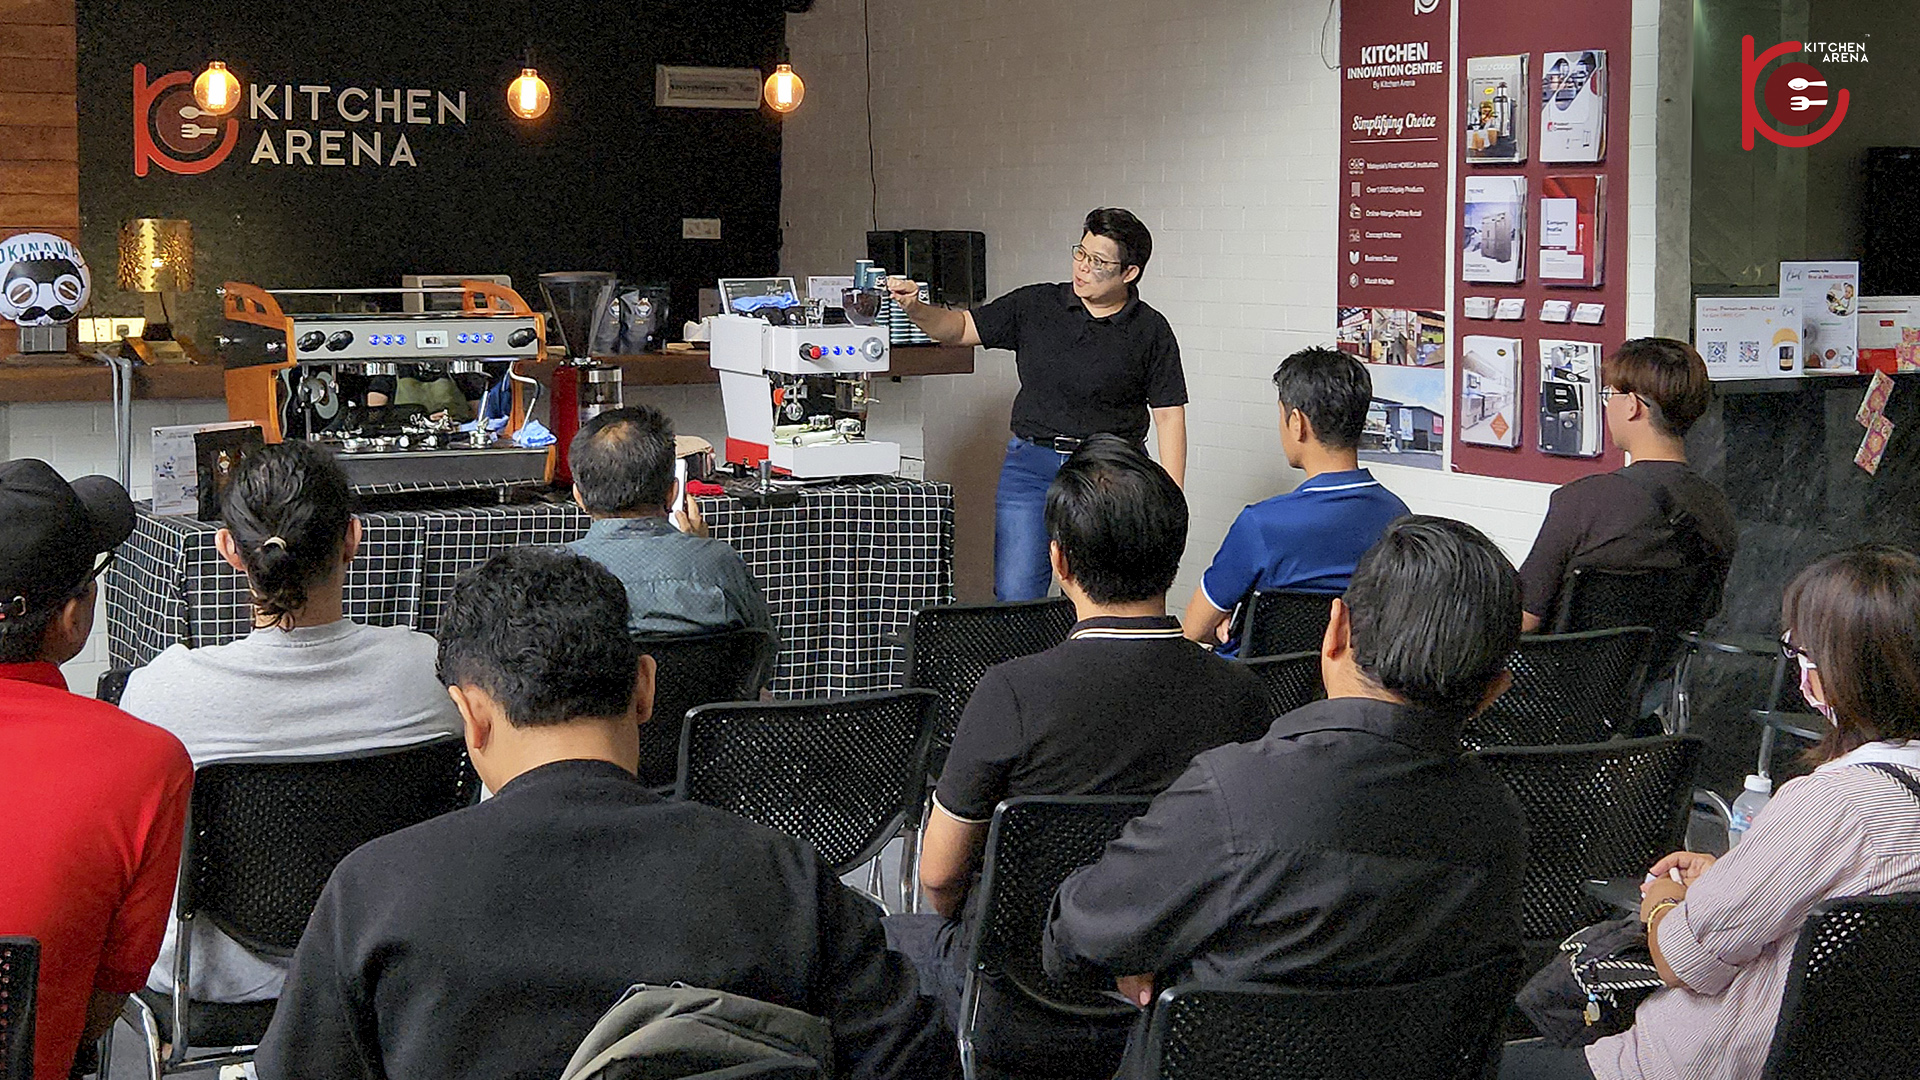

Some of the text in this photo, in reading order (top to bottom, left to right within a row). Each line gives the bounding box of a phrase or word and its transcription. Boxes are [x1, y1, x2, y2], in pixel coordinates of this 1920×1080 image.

[1361, 42, 1428, 65] KITCHEN
[1347, 61, 1443, 79] INNOVATION CENTRE
[250, 84, 466, 125] KITCHEN
[1352, 113, 1437, 136] Simplifying Choice
[250, 129, 418, 167] ARENA
